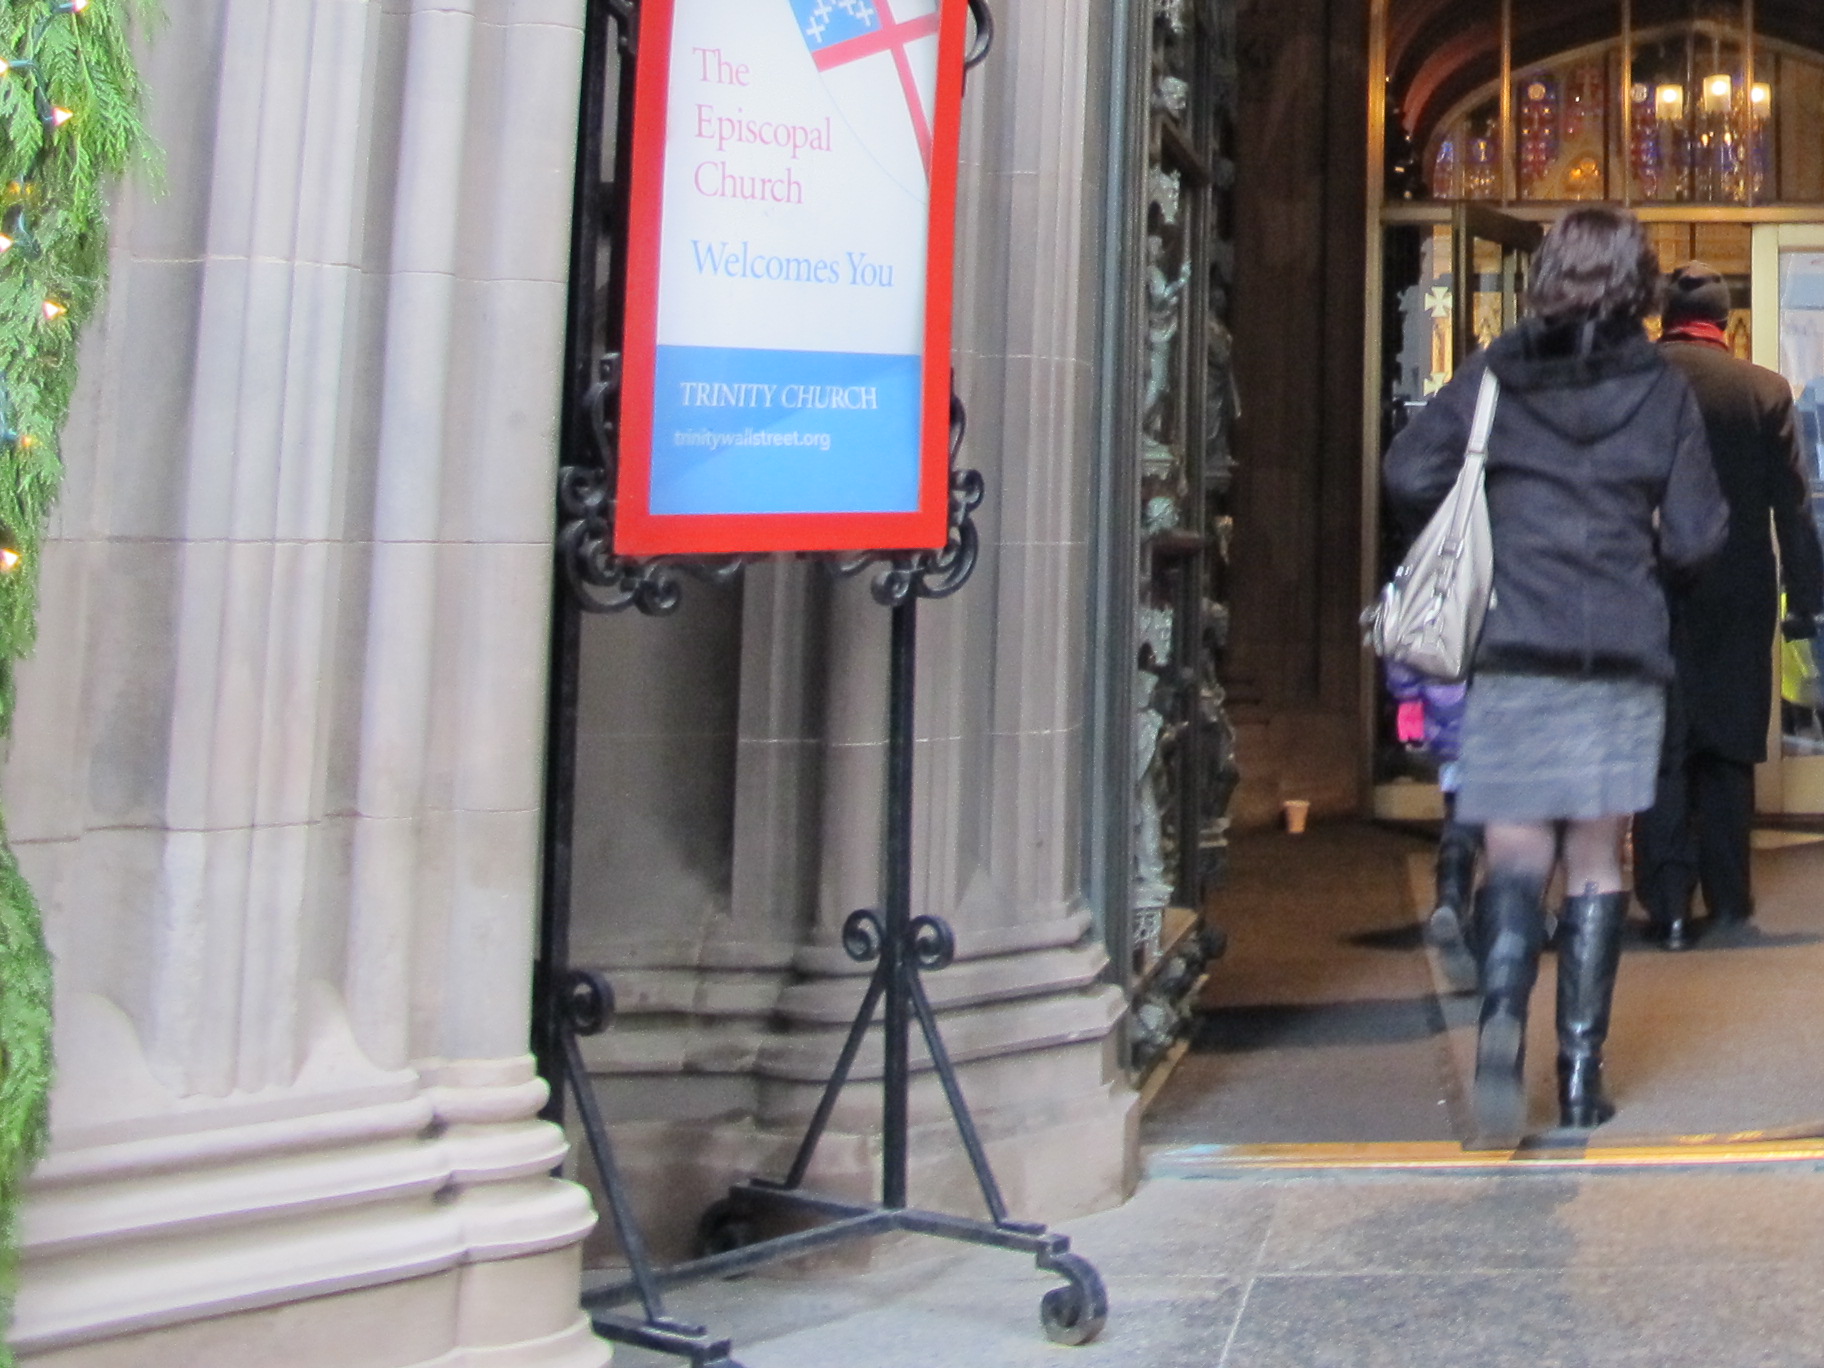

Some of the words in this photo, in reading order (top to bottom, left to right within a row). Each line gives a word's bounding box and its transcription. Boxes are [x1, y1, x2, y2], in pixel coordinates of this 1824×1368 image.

[693, 47, 750, 87] The
[694, 104, 832, 159] Episcopal
[693, 161, 803, 204] Church
[690, 239, 839, 286] Welcomes
[847, 251, 895, 289] You
[680, 381, 777, 410] TRINITY
[780, 384, 878, 411] CHURCH
[674, 426, 831, 452] trinitywallstreet.org
